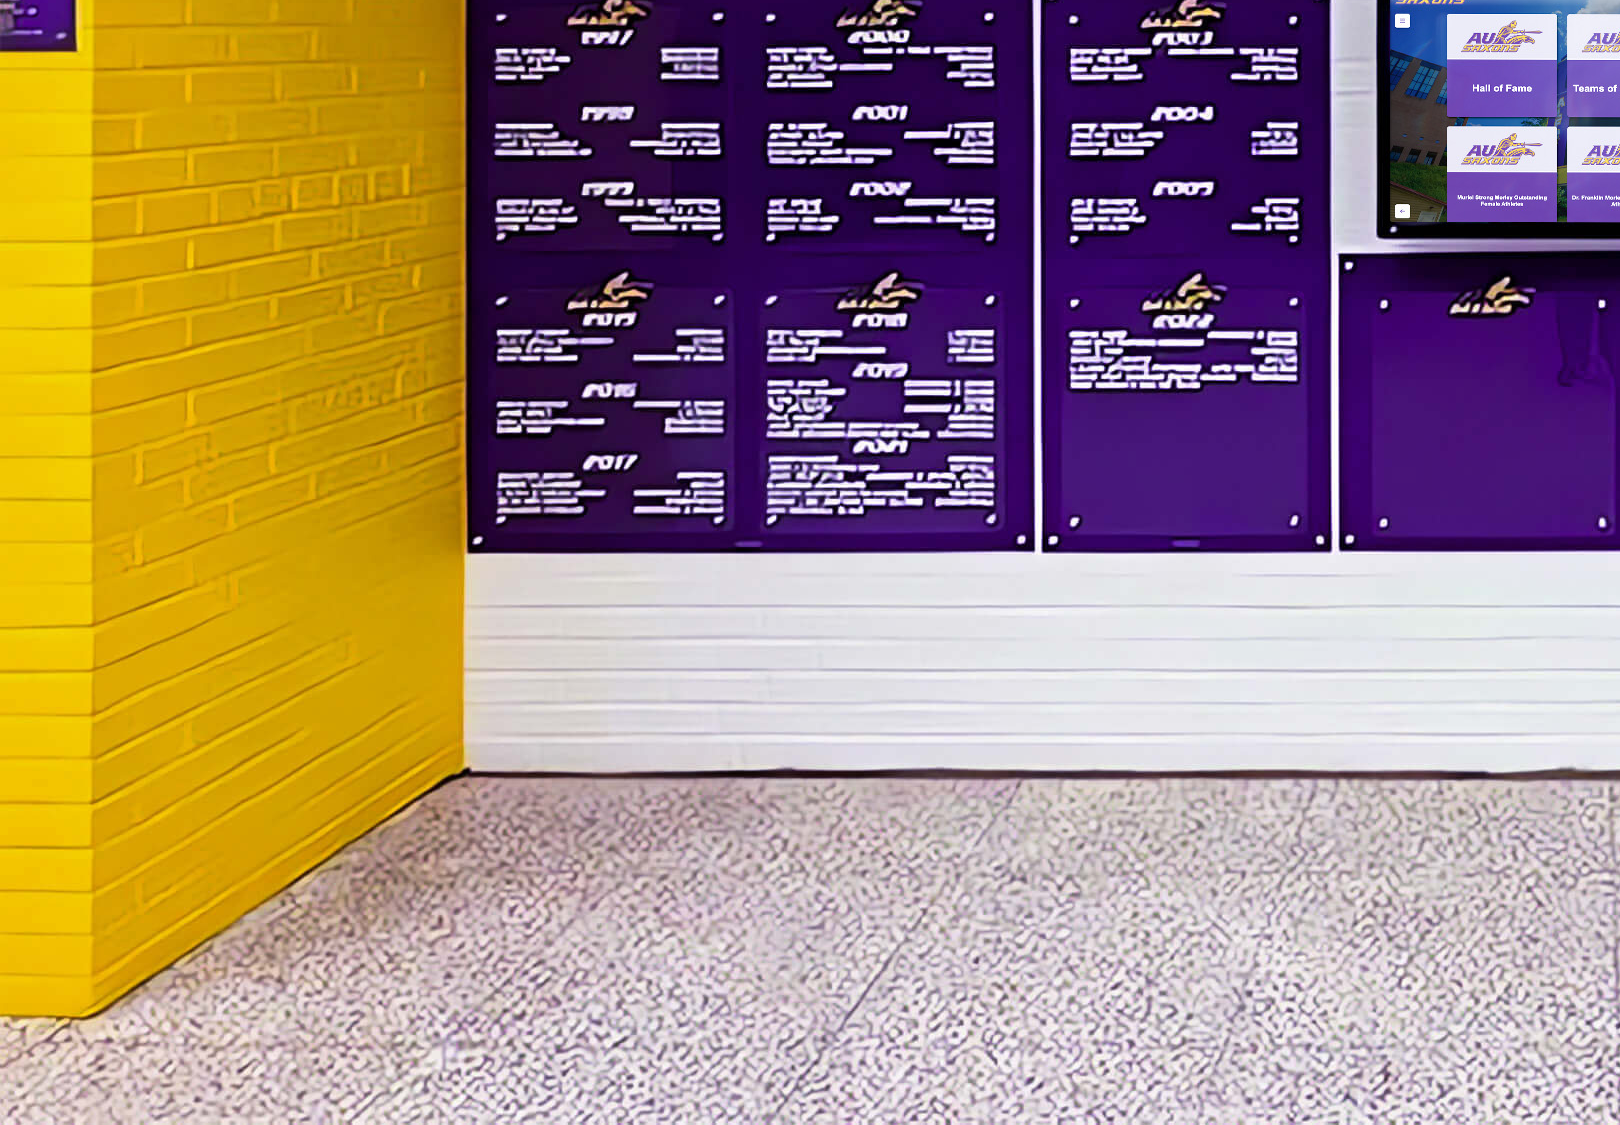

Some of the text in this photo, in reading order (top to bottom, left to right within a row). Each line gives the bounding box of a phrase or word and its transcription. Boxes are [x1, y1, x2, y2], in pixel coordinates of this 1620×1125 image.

[1466, 32, 1496, 44] AU
[1587, 32, 1617, 44] AU
[1461, 44, 1520, 52] SAXONS
[1472, 84, 1533, 93] Hall of Fame
[1573, 84, 1604, 93] Teams
[1607, 84, 1618, 93] of
[1466, 145, 1496, 156] AU
[1587, 145, 1617, 157] AU
[1461, 157, 1520, 165] SAXONS
